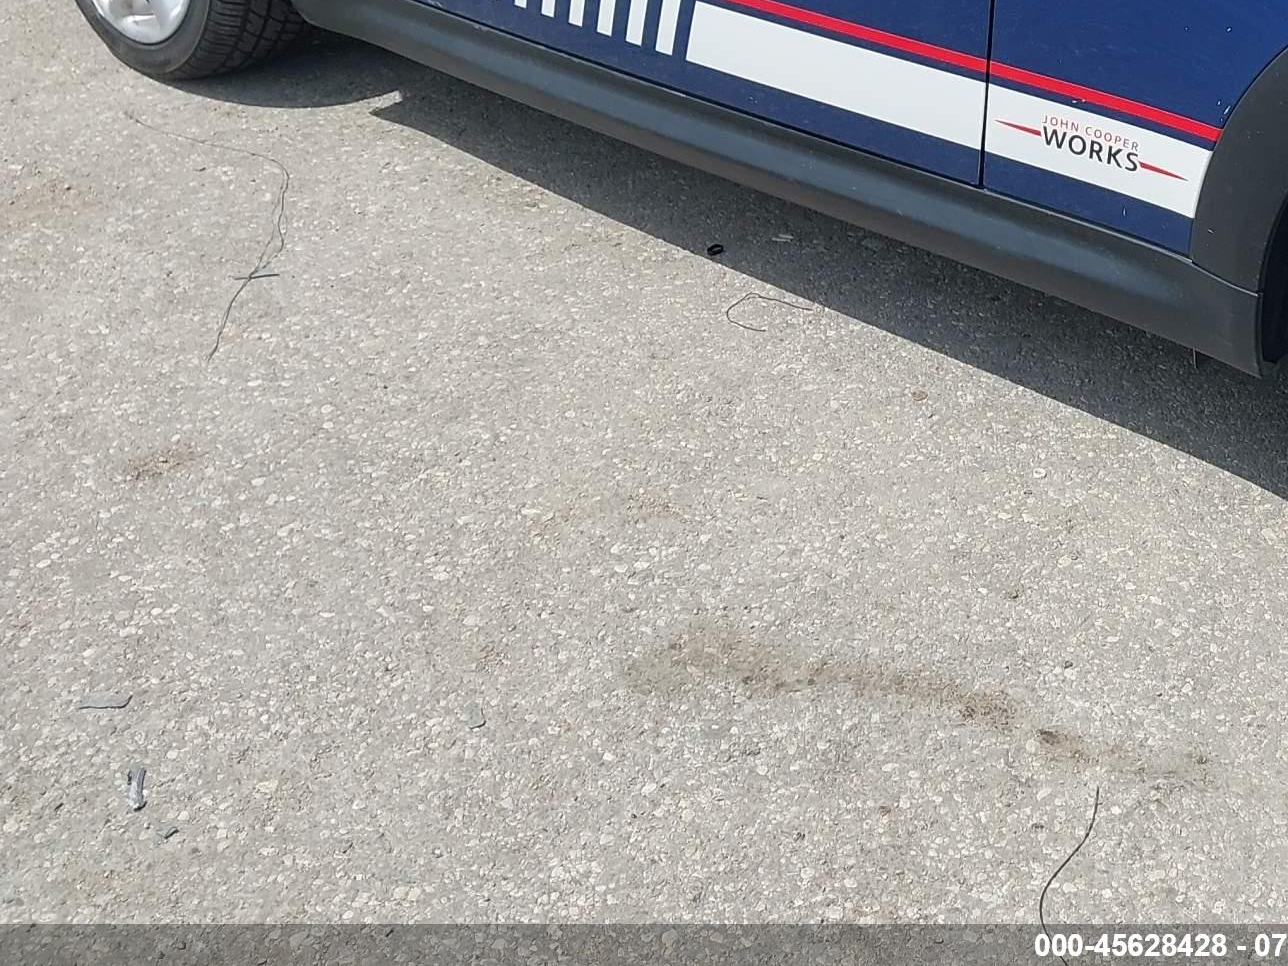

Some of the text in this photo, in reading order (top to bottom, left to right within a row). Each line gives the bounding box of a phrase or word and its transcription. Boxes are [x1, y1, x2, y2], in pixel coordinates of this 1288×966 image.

[1042, 114, 1139, 152] JOHN COOPER
[1043, 125, 1139, 172] WORKS
